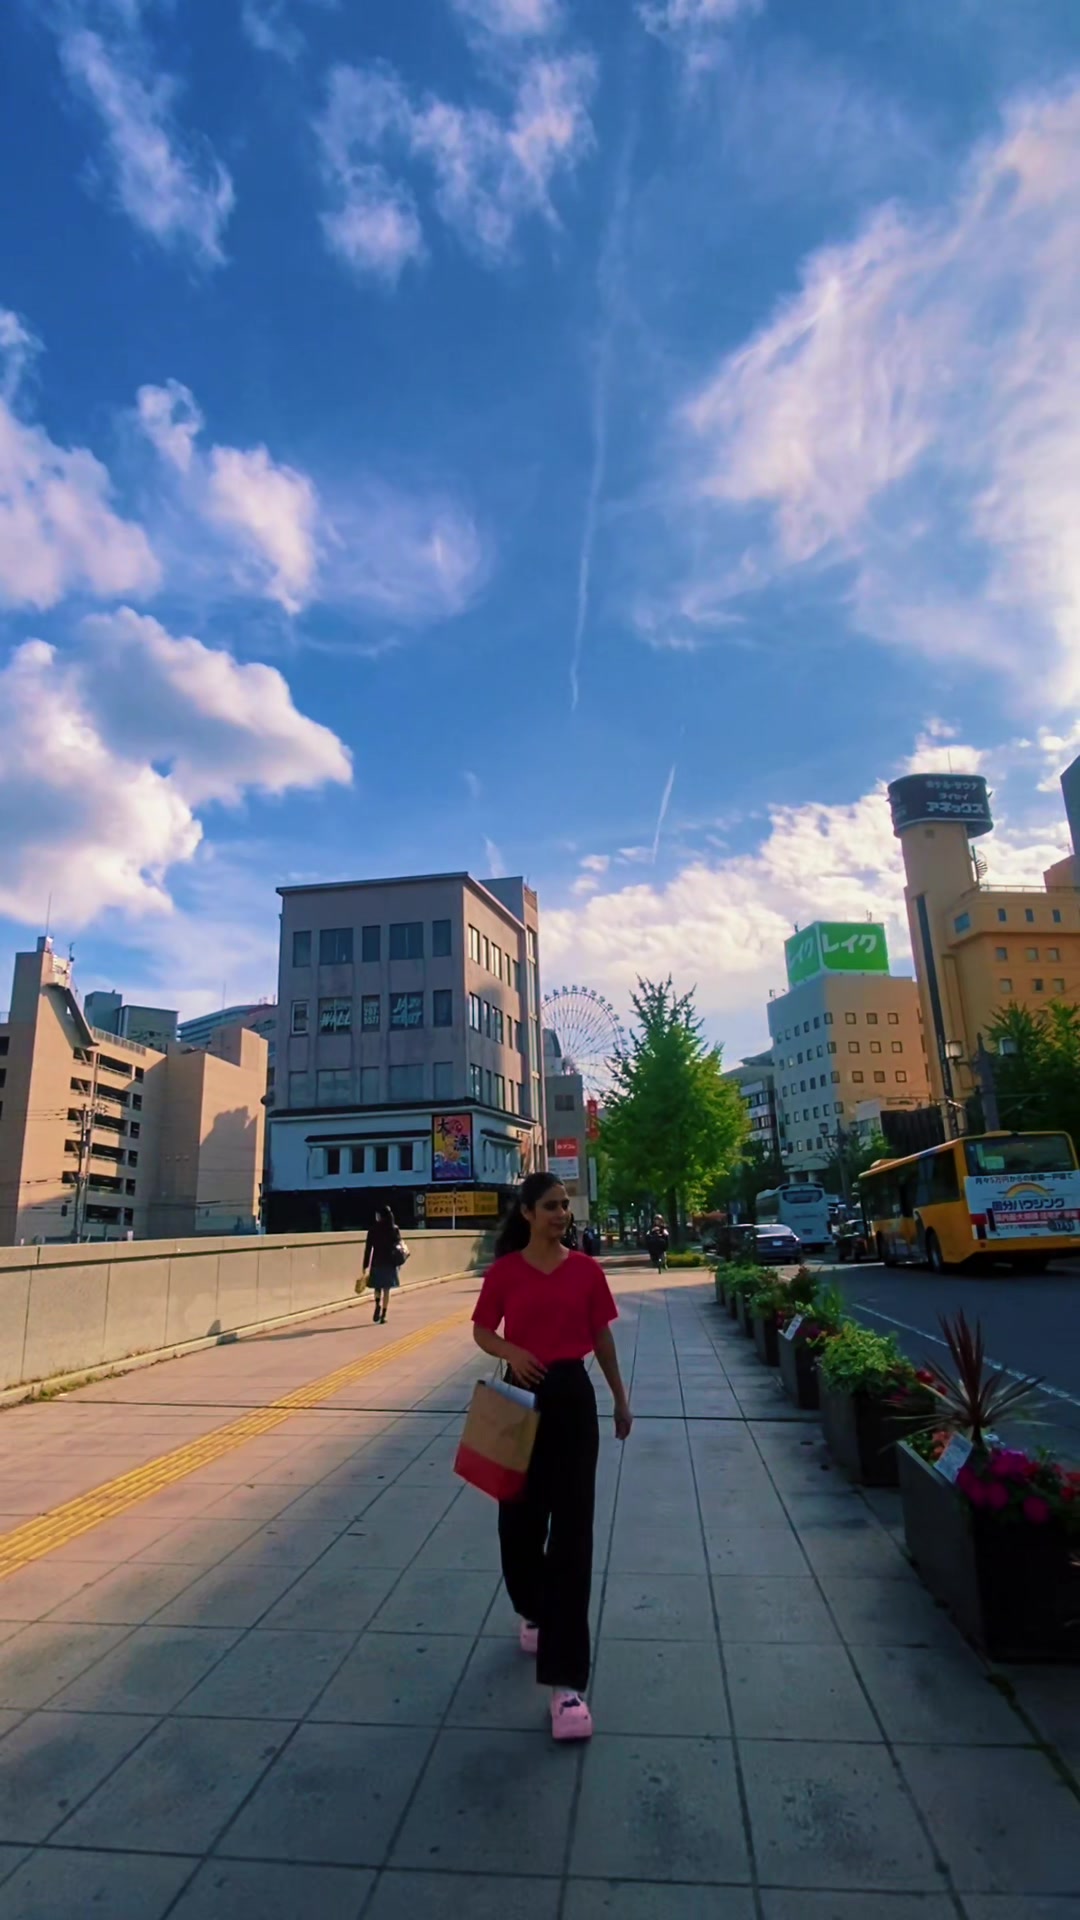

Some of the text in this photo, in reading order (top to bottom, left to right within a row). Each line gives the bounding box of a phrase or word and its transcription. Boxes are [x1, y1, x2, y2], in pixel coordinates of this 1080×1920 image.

[926, 802, 984, 813] アネックス
[822, 934, 877, 953] レイク
